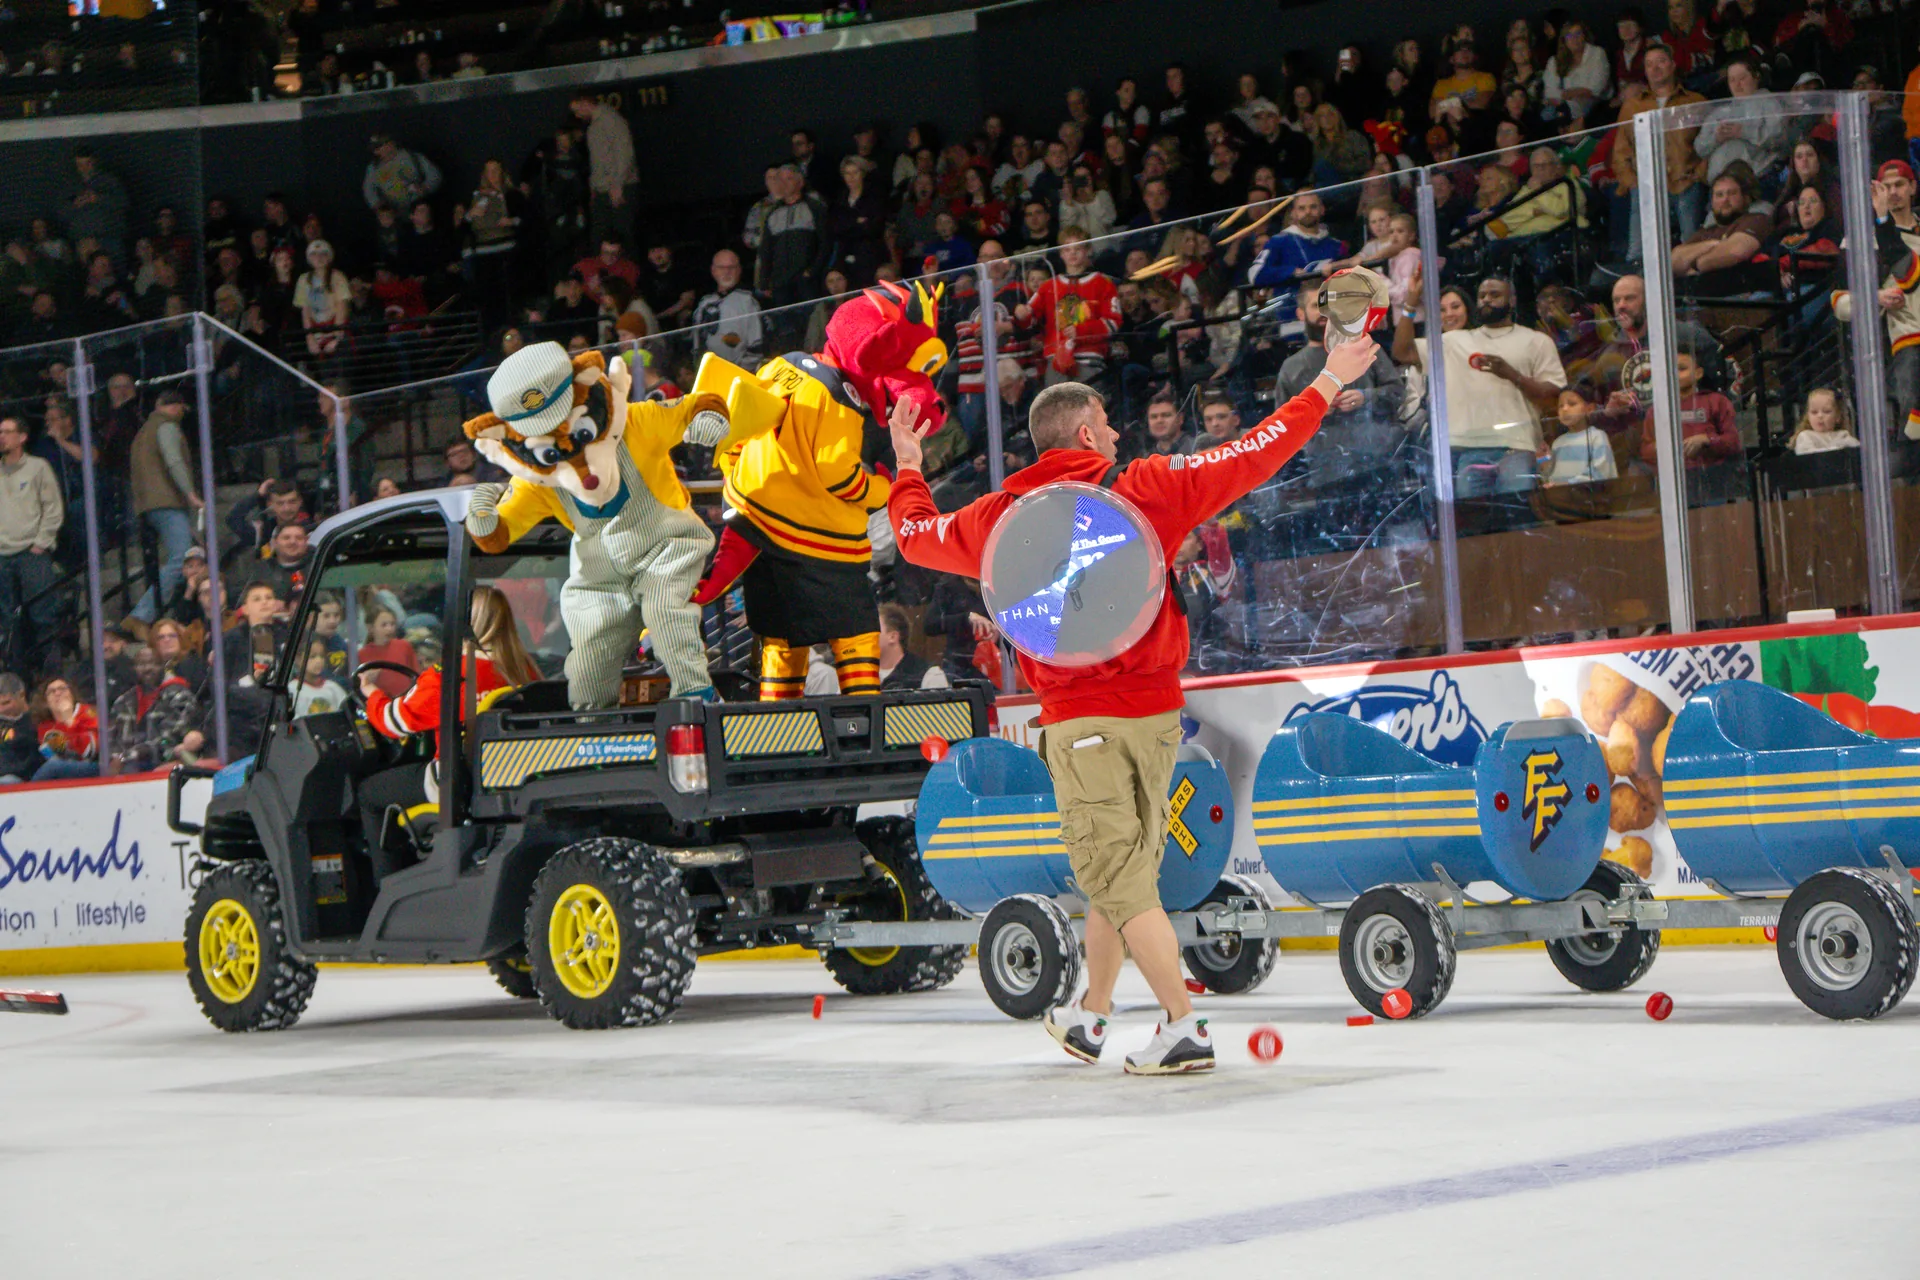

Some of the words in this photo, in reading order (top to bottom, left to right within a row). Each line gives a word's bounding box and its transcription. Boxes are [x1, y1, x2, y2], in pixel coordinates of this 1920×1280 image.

[0, 808, 144, 890] Sounds
[1678, 866, 1701, 884] MA
[77, 901, 147, 931] lifestyle
